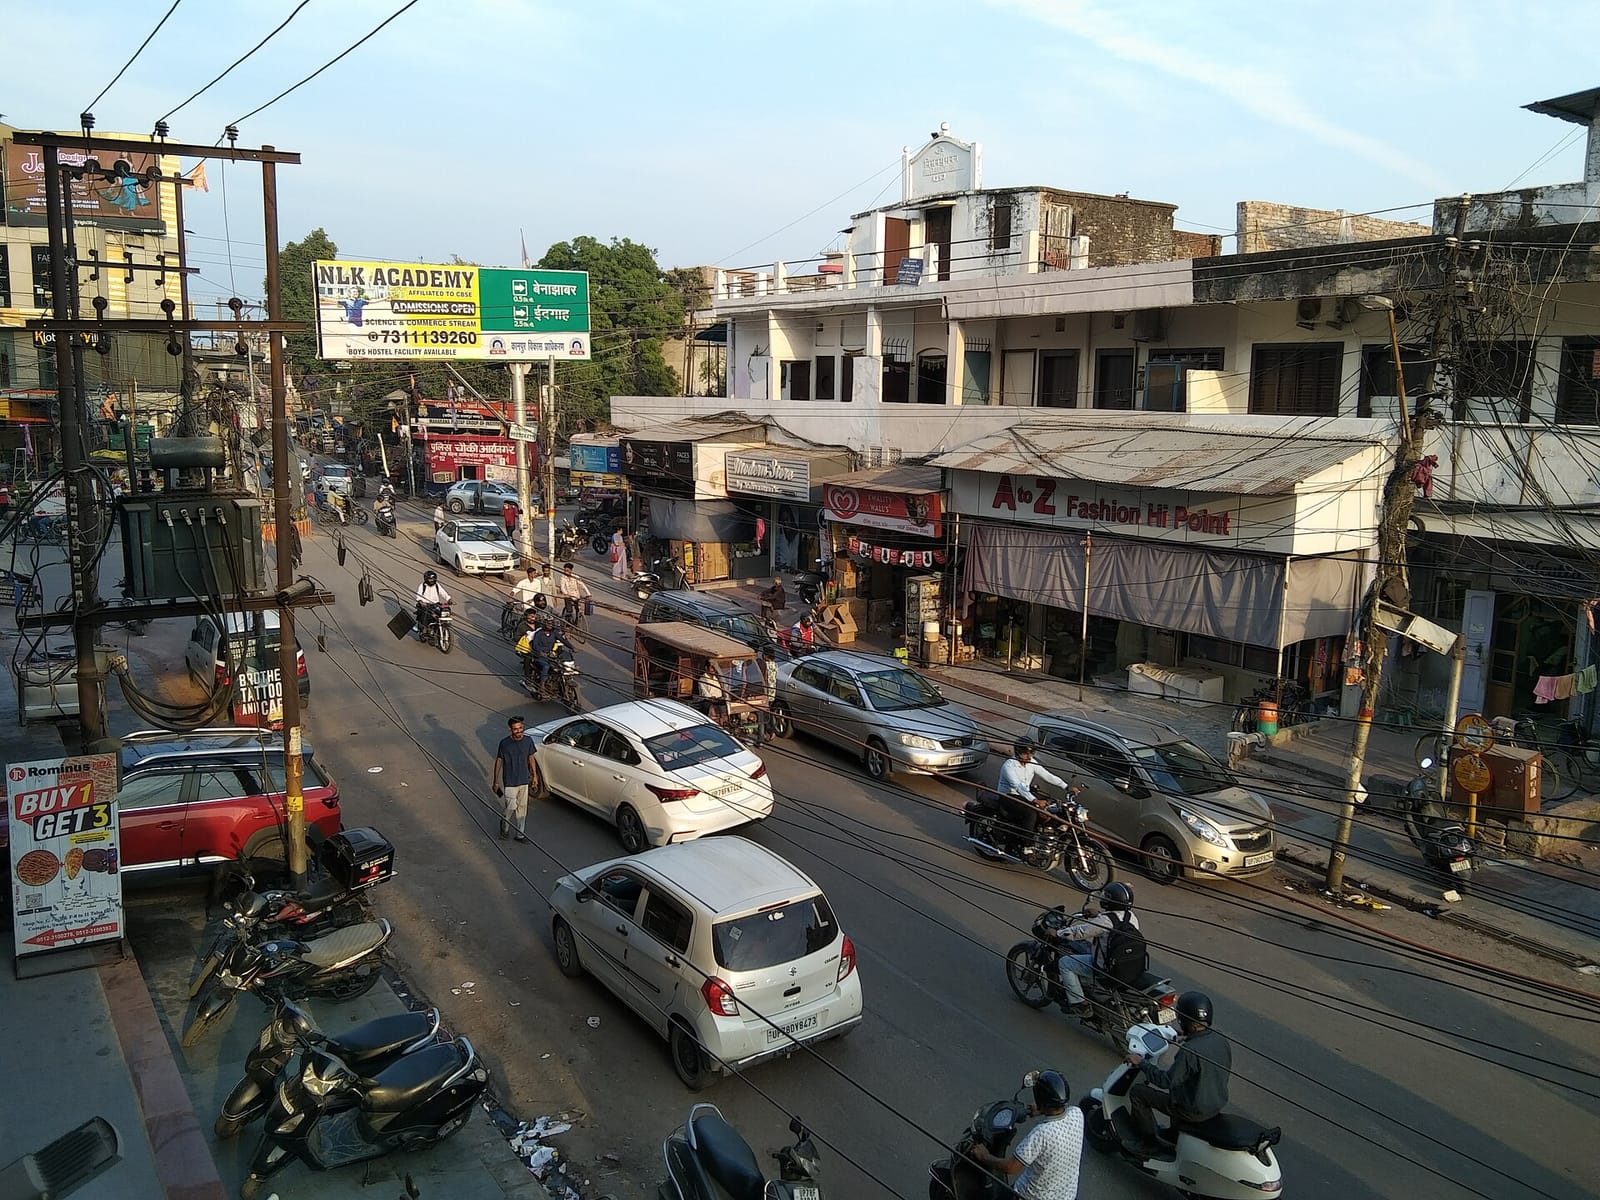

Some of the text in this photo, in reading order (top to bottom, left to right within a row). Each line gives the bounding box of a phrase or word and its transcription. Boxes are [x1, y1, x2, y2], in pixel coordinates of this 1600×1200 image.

[319, 266, 474, 289] NLK ACADEMY
[393, 303, 475, 314] ADMISSIONS OPEN
[406, 319, 447, 327] COMMERCE
[381, 330, 477, 344] 7311139260
[348, 348, 366, 356] BOYS
[367, 348, 393, 356] HOSTEL
[992, 475, 1231, 536] A to Z Fashion Hi Point
[239, 668, 281, 687] BROTHE
[240, 682, 282, 703] TATTOO
[28, 763, 91, 777] Rominus
[20, 783, 92, 816] BUY 1
[35, 807, 90, 840] GET
[92, 804, 109, 827] 3
